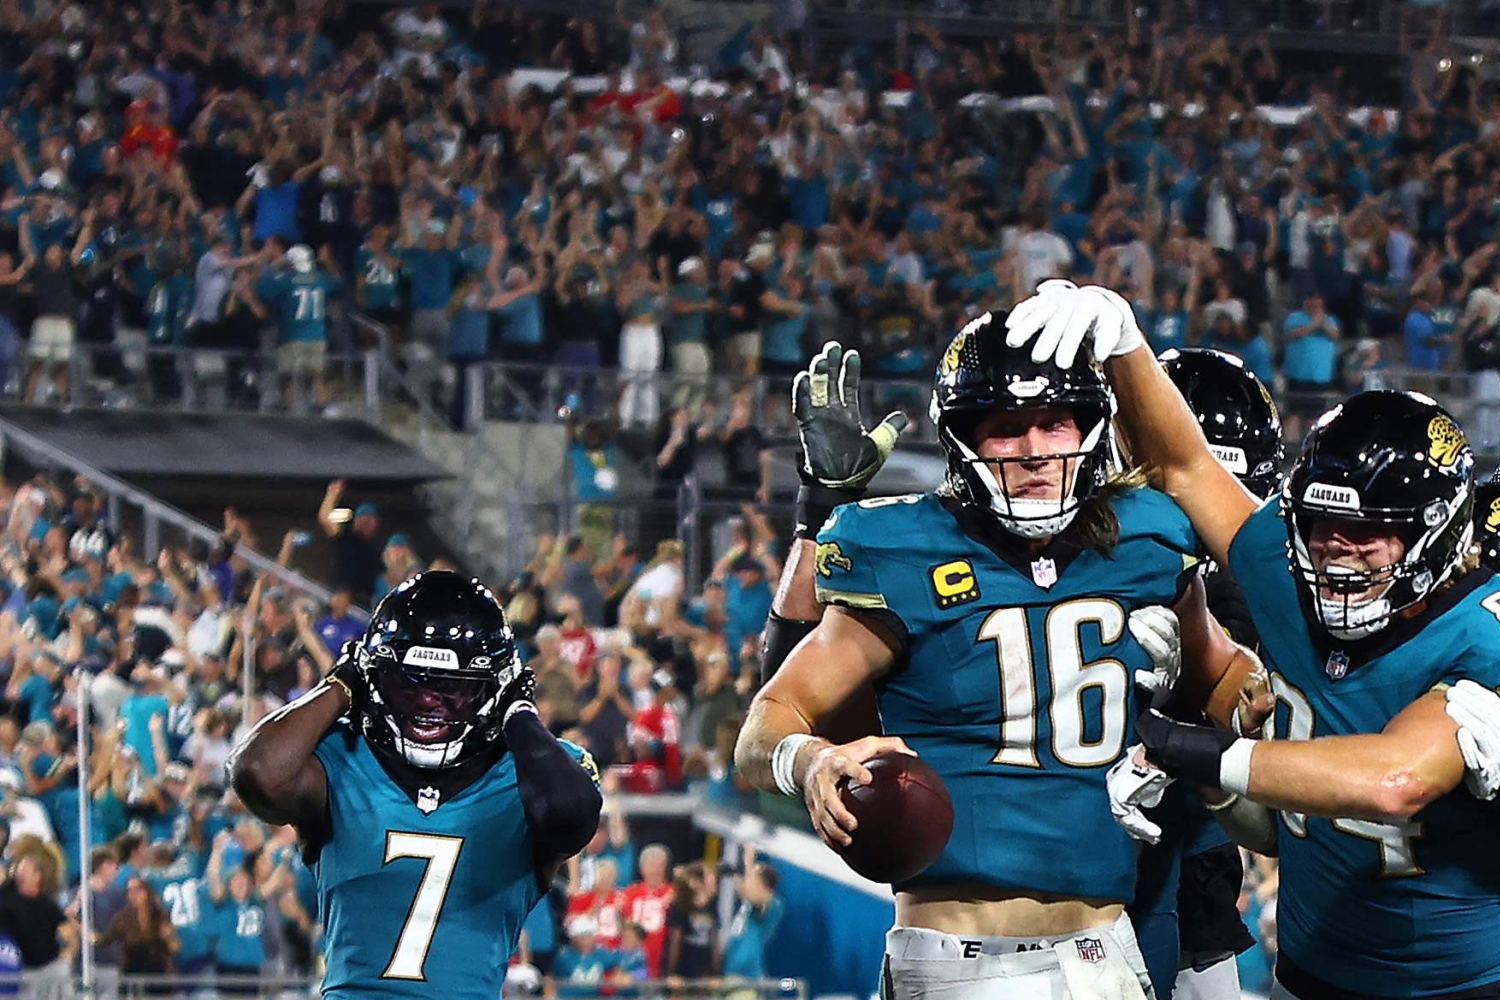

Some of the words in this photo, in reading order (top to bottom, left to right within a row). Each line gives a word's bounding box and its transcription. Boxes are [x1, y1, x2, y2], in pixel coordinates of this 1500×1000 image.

[292, 286, 325, 320] 71
[1310, 487, 1351, 504] JAGUARS
[932, 560, 976, 597] C
[412, 649, 451, 662] JAGUARS
[974, 597, 1129, 770] 16
[380, 829, 465, 982] 7
[1081, 948, 1103, 961] NFL
